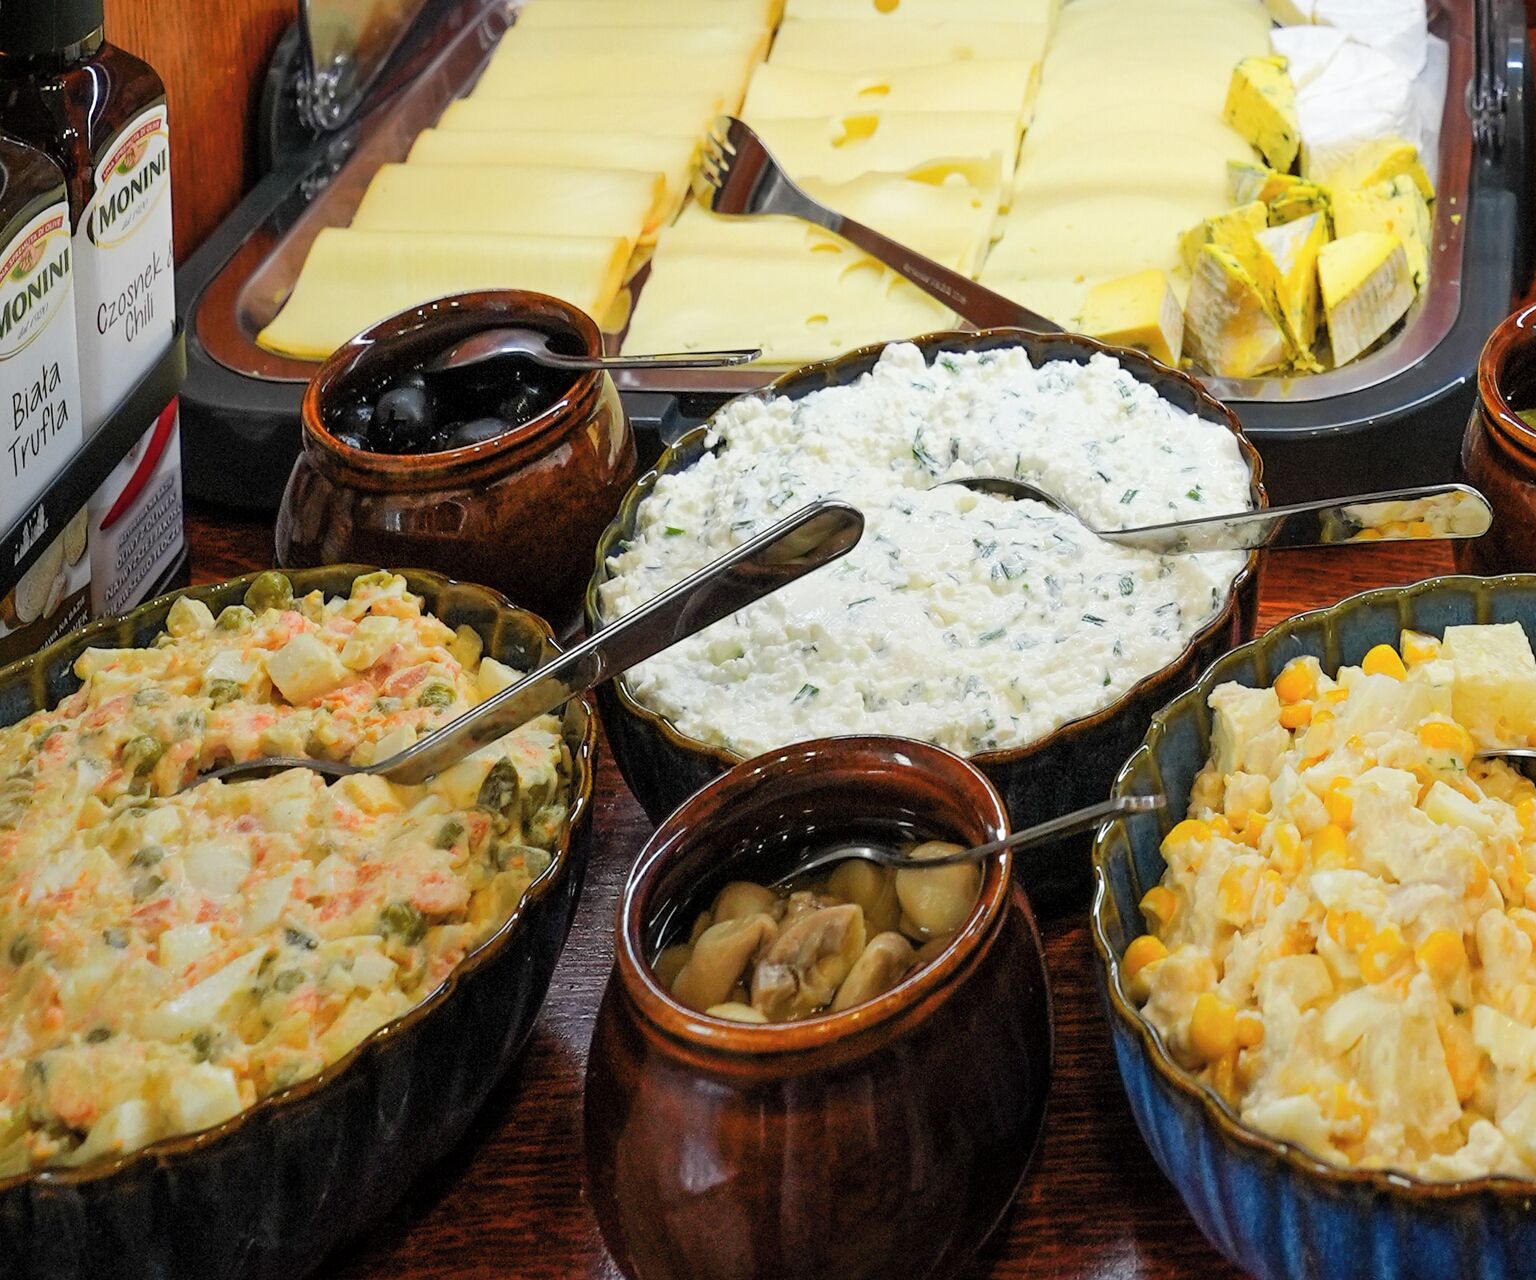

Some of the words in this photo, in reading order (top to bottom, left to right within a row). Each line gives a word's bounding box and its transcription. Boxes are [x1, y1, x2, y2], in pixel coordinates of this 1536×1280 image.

[99, 148, 167, 234] MONINI
[97, 250, 163, 336] Czosnek
[125, 292, 155, 343] Chili
[12, 361, 62, 431] Biała
[8, 399, 69, 477] Trufla
